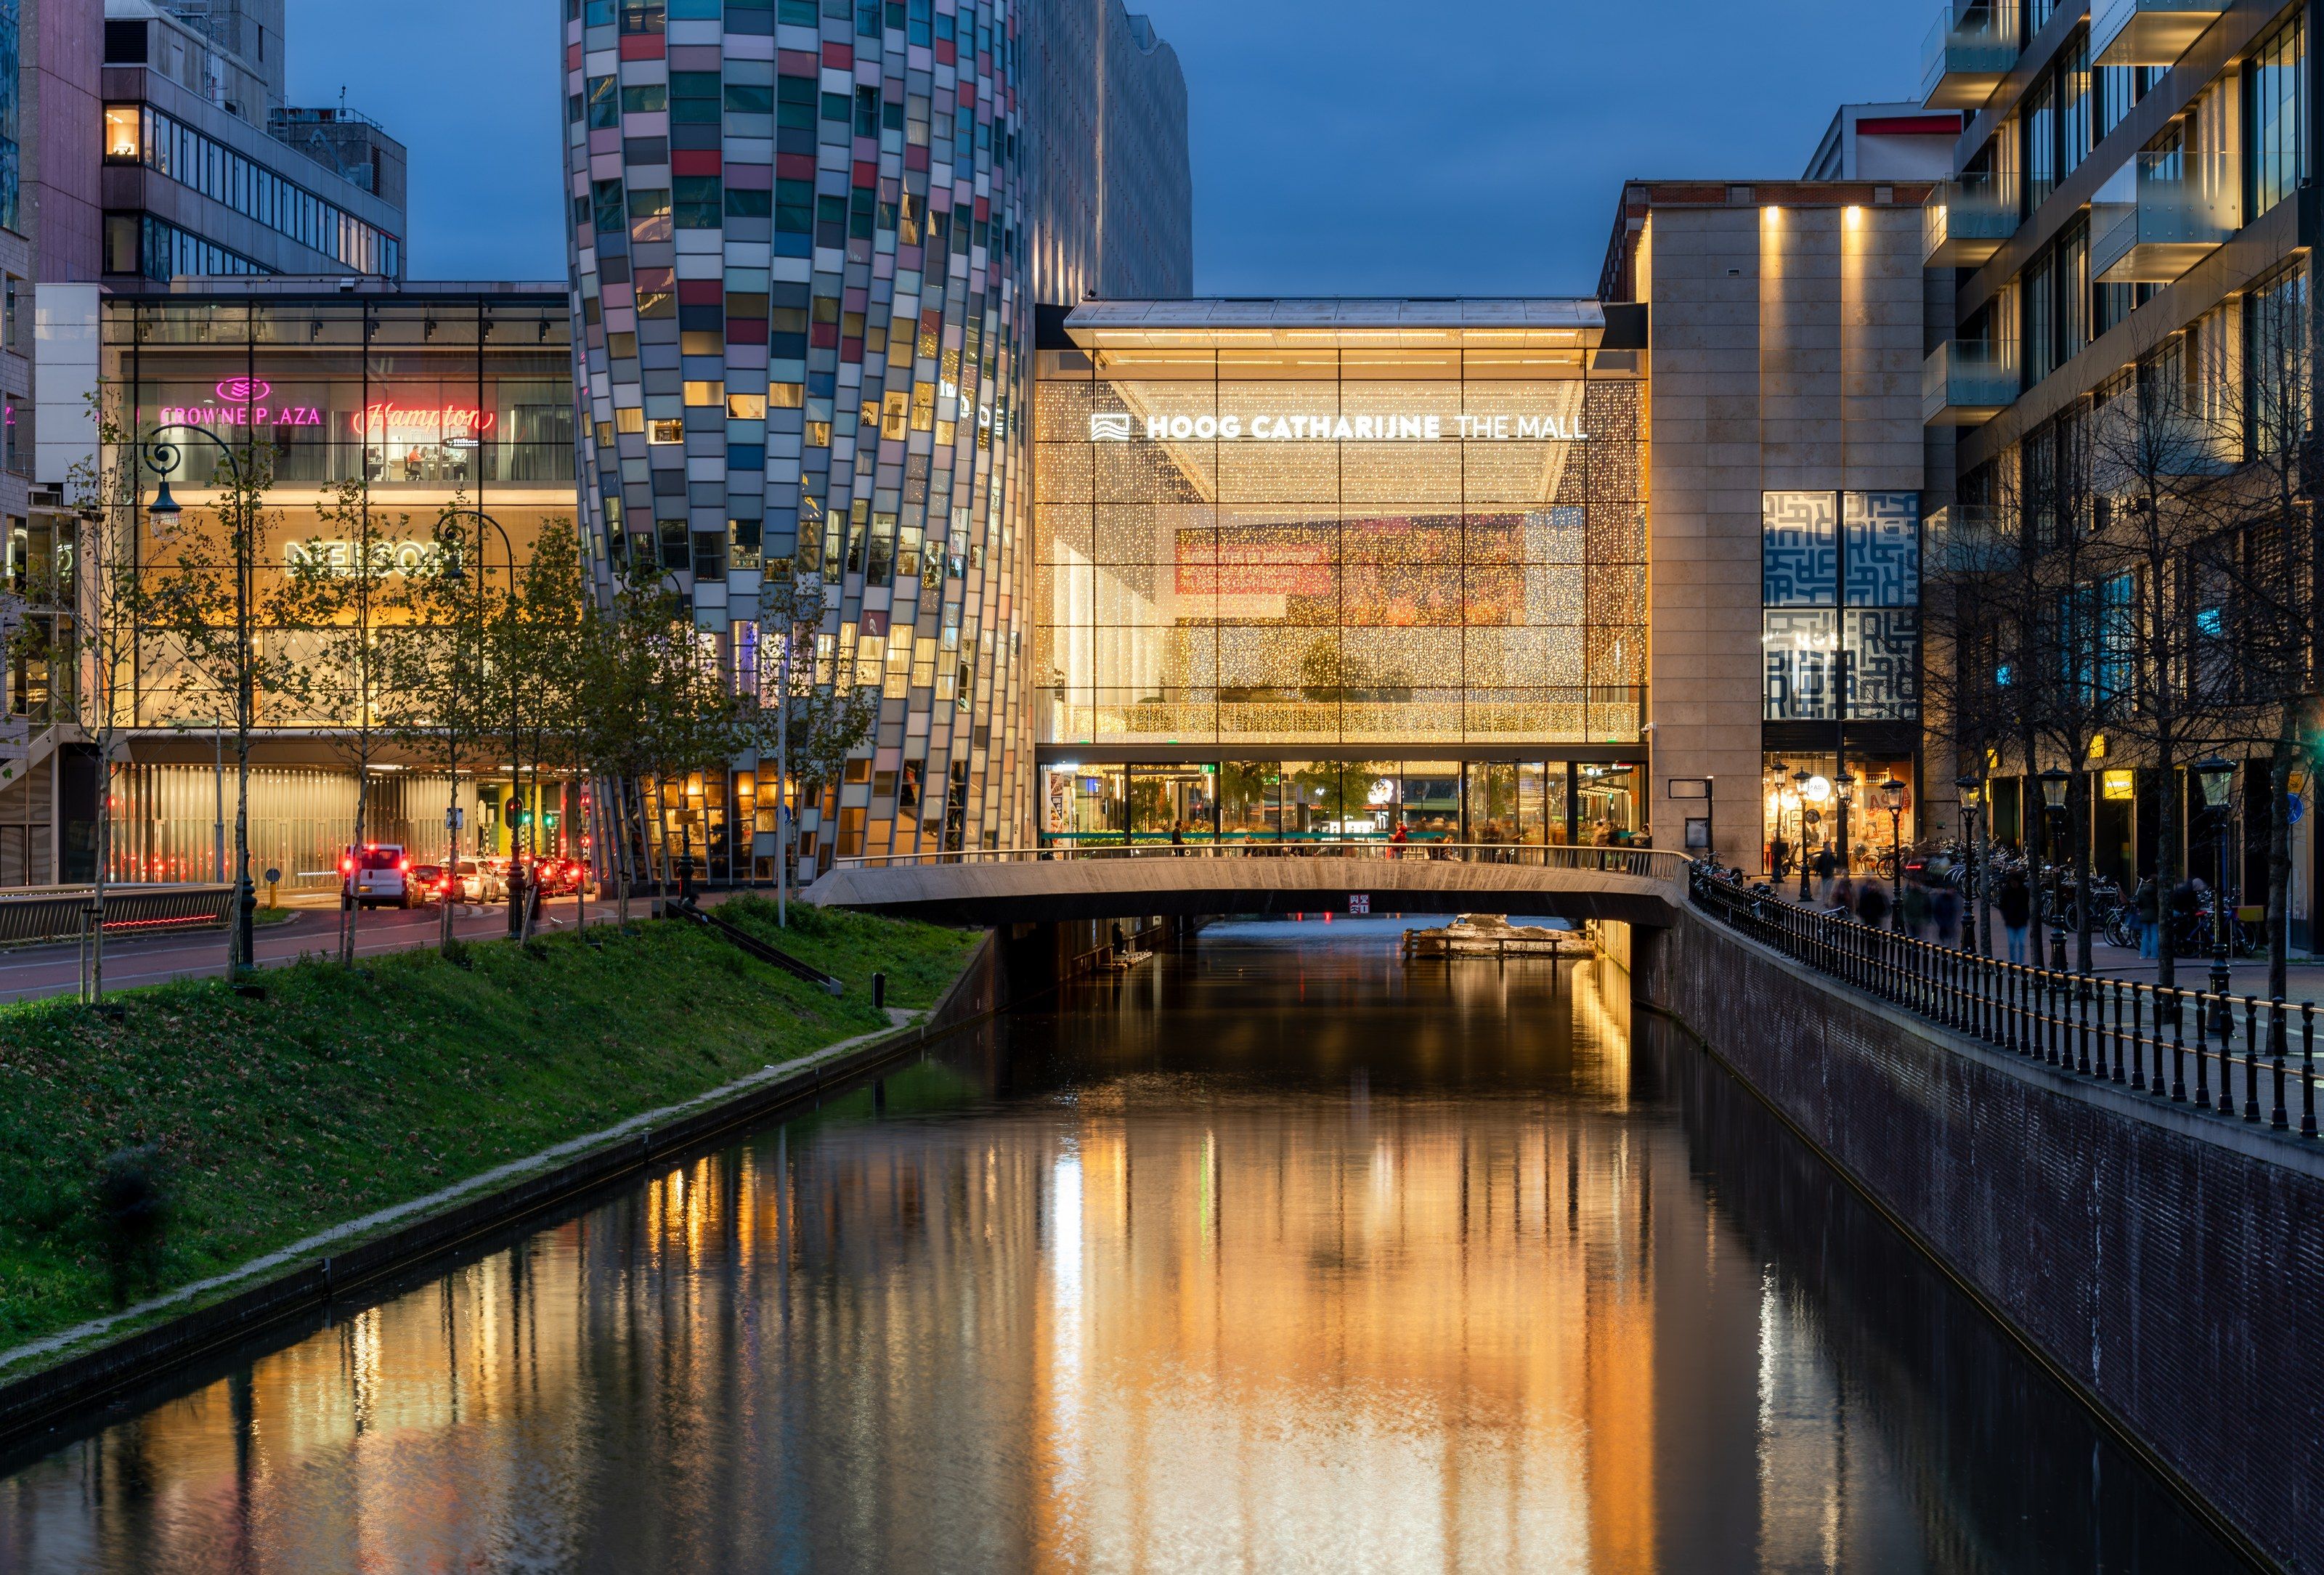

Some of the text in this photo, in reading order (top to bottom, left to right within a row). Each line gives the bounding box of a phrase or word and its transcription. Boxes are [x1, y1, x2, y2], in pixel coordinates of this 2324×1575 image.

[161, 407, 247, 425] CROWNE
[352, 401, 495, 434] Hampton
[1147, 415, 1588, 439] HOOG CATHARIJNE THE MALL
